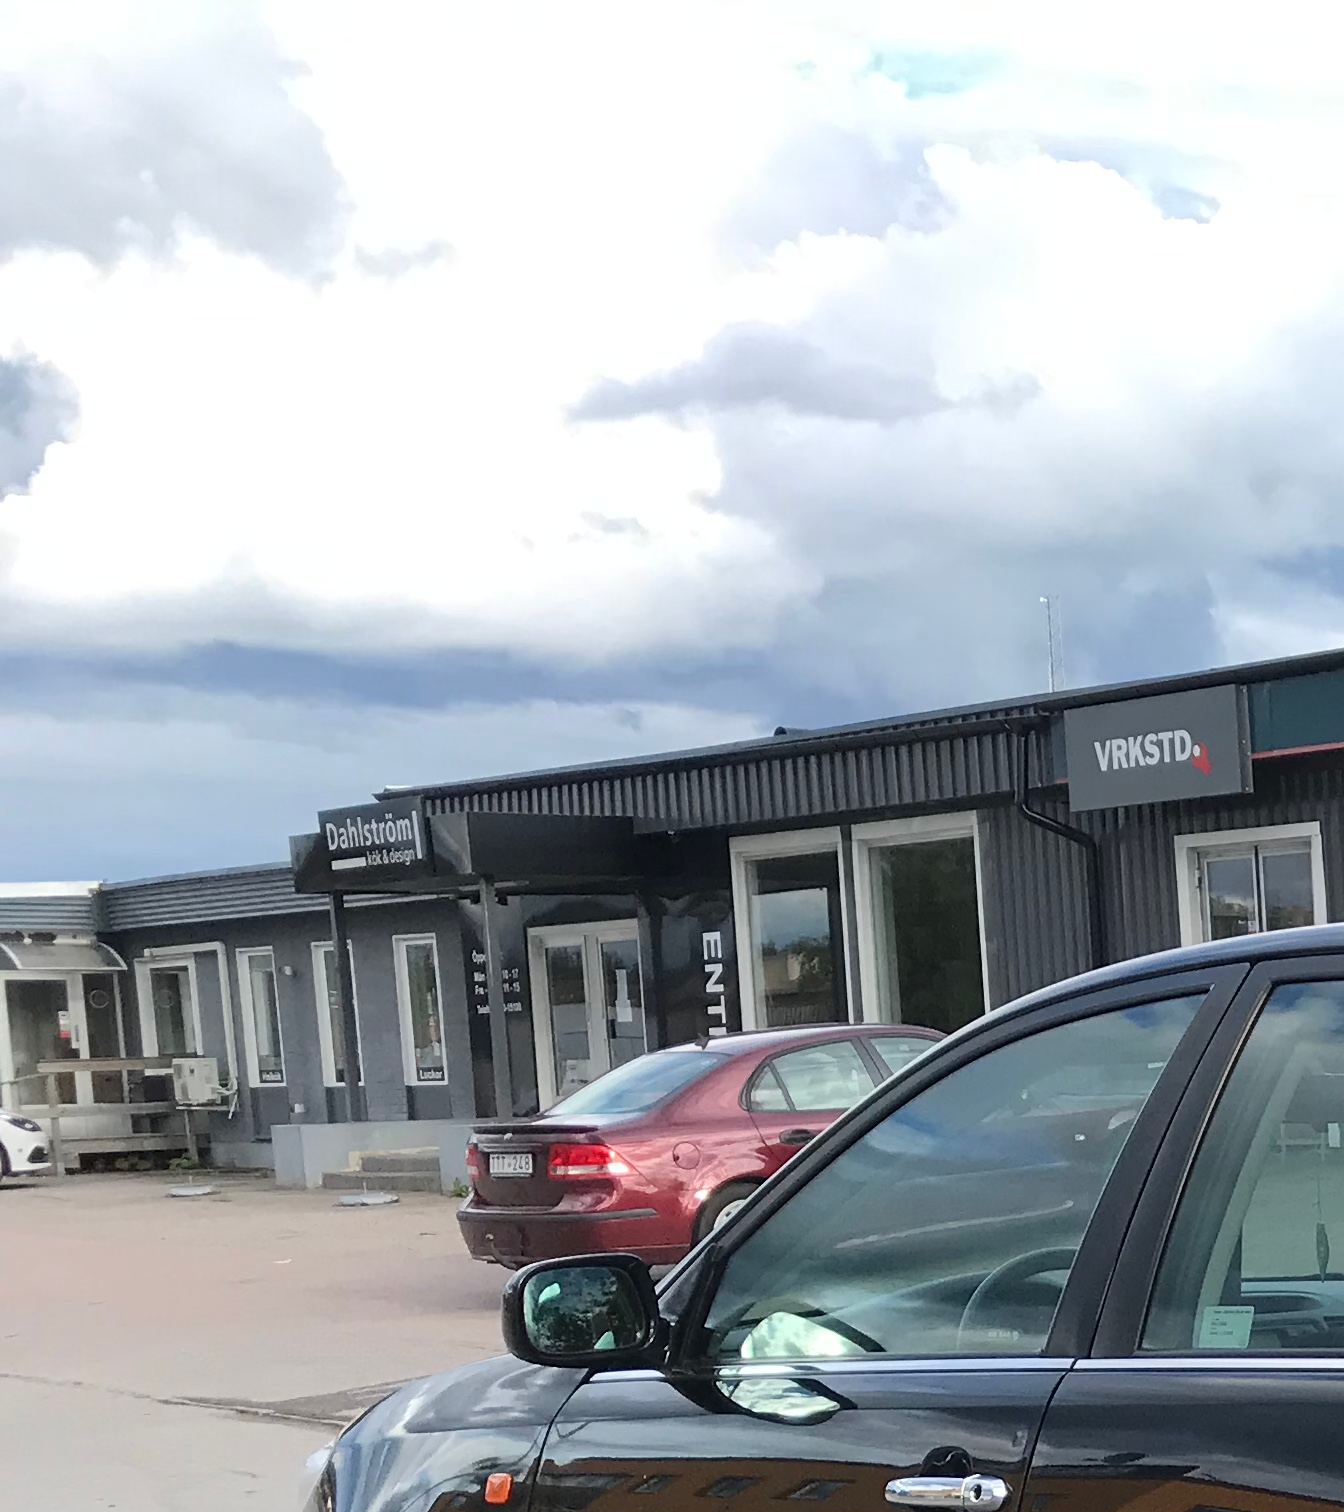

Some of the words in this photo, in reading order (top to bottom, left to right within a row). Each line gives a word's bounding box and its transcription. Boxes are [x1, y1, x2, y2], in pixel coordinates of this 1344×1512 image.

[325, 812, 413, 851] Dahlström
[367, 849, 382, 866] kök
[383, 848, 389, 864] &
[390, 847, 415, 866] design
